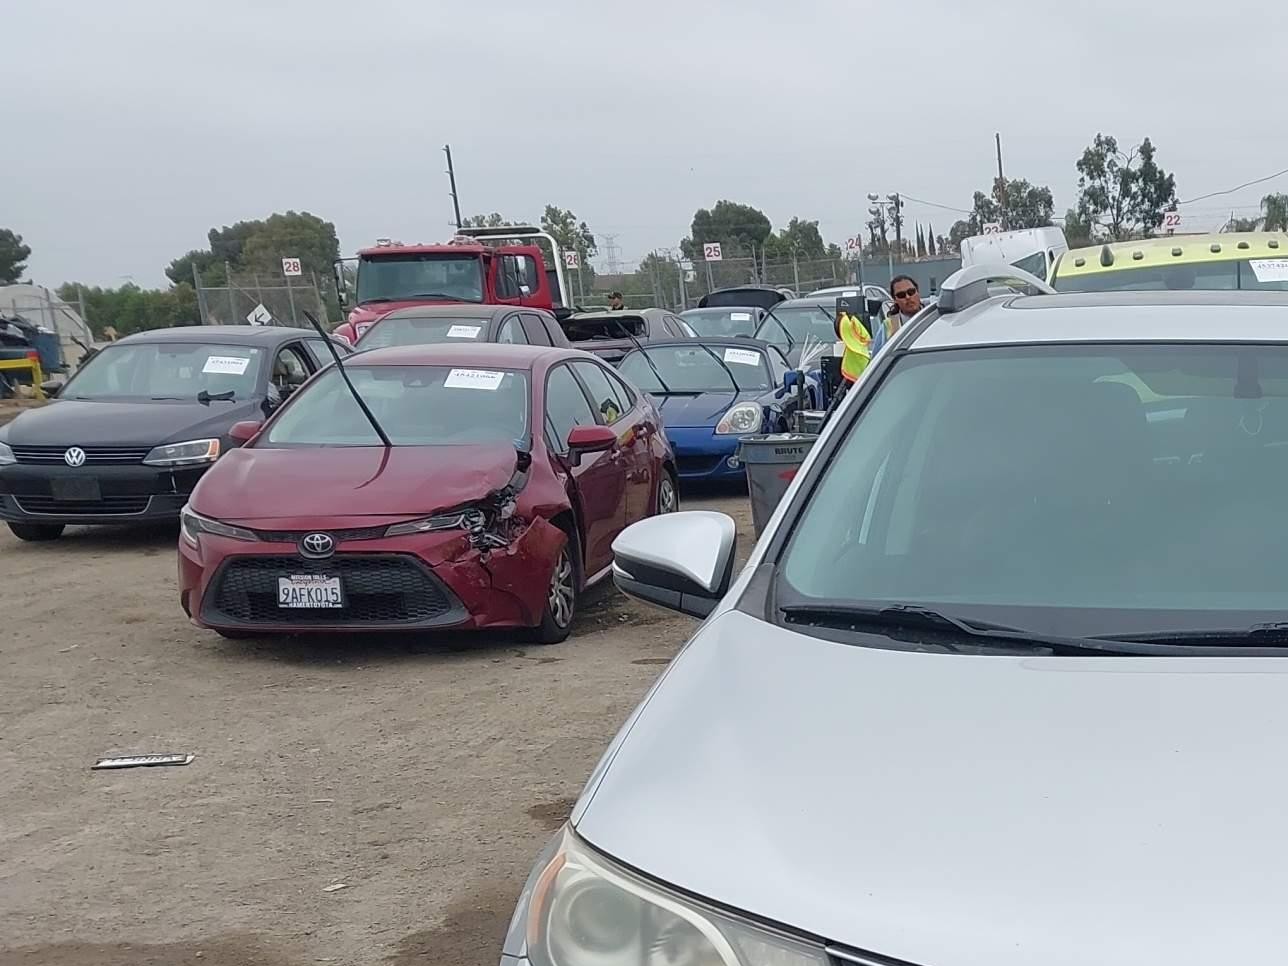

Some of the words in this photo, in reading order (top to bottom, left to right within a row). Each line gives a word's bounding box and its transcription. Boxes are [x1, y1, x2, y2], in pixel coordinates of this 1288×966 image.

[1166, 215, 1181, 226] 22
[705, 246, 721, 257] 25
[284, 261, 300, 272] 28
[282, 587, 339, 603] 9AFK015
